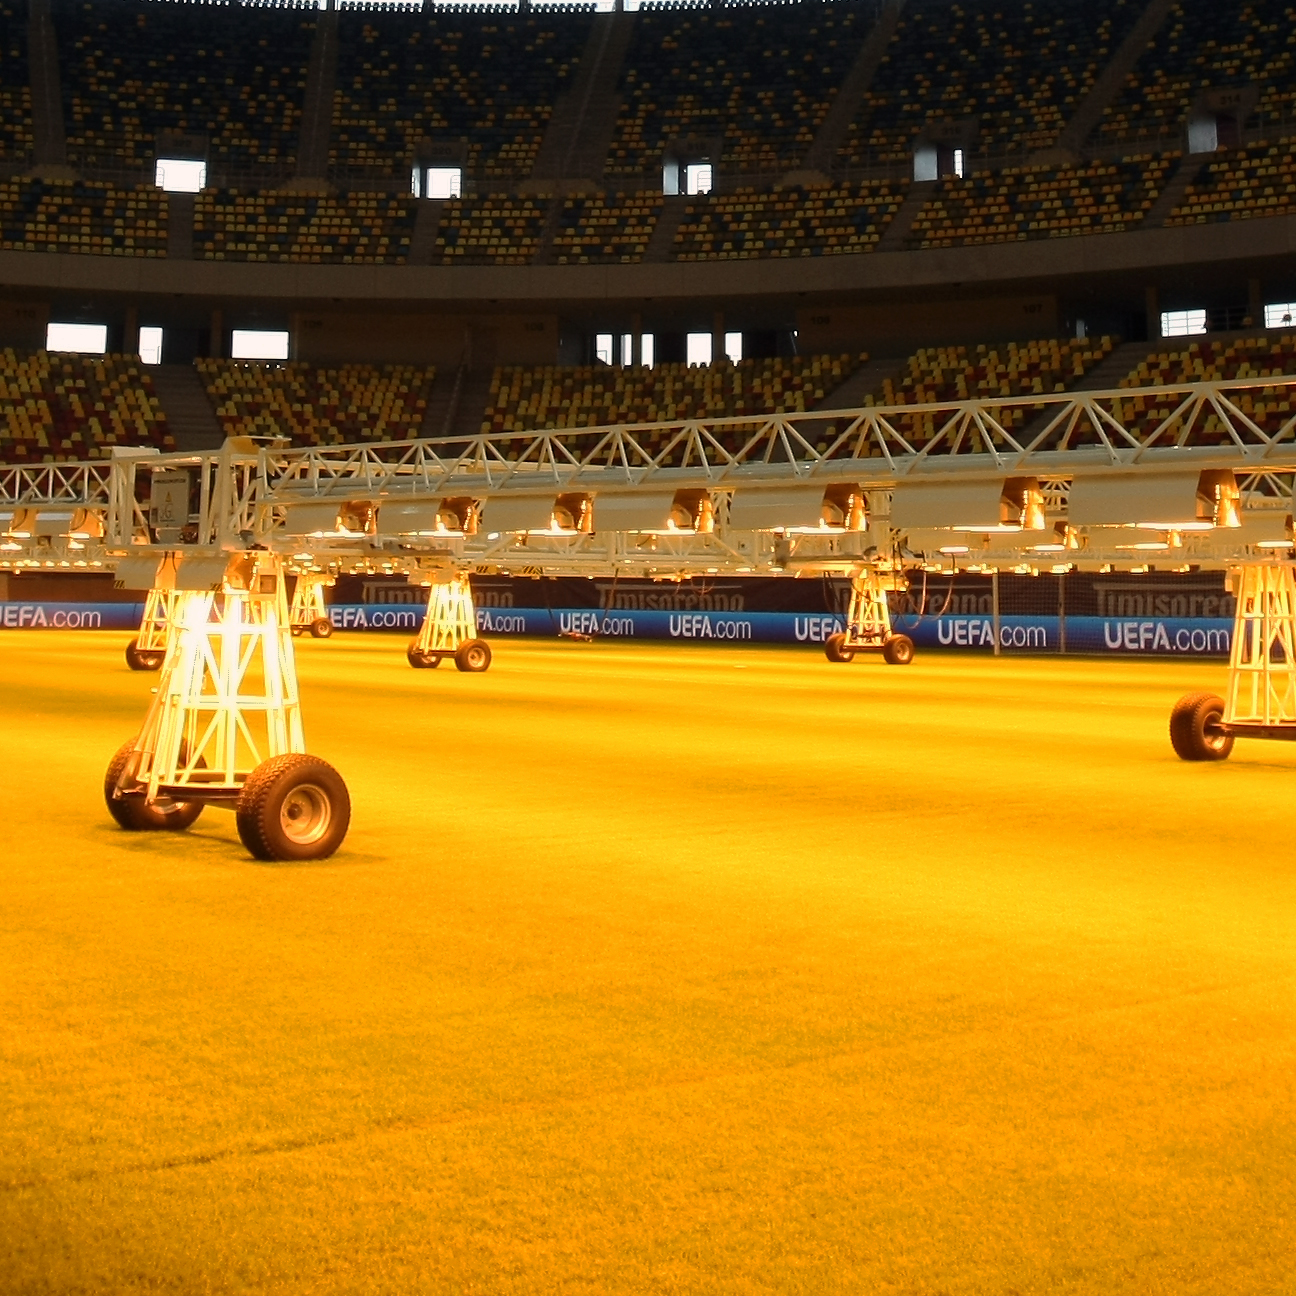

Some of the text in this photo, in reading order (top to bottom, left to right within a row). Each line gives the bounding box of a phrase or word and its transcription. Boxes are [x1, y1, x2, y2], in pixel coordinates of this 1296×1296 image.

[1219, 94, 1241, 106] 314
[15, 309, 36, 319] 110
[1022, 303, 1043, 313] 107
[325, 608, 416, 628] EFA.com
[559, 612, 634, 635] UEFA.com
[669, 614, 751, 639] UEFA.com
[1104, 622, 1230, 652] UEFA.com
